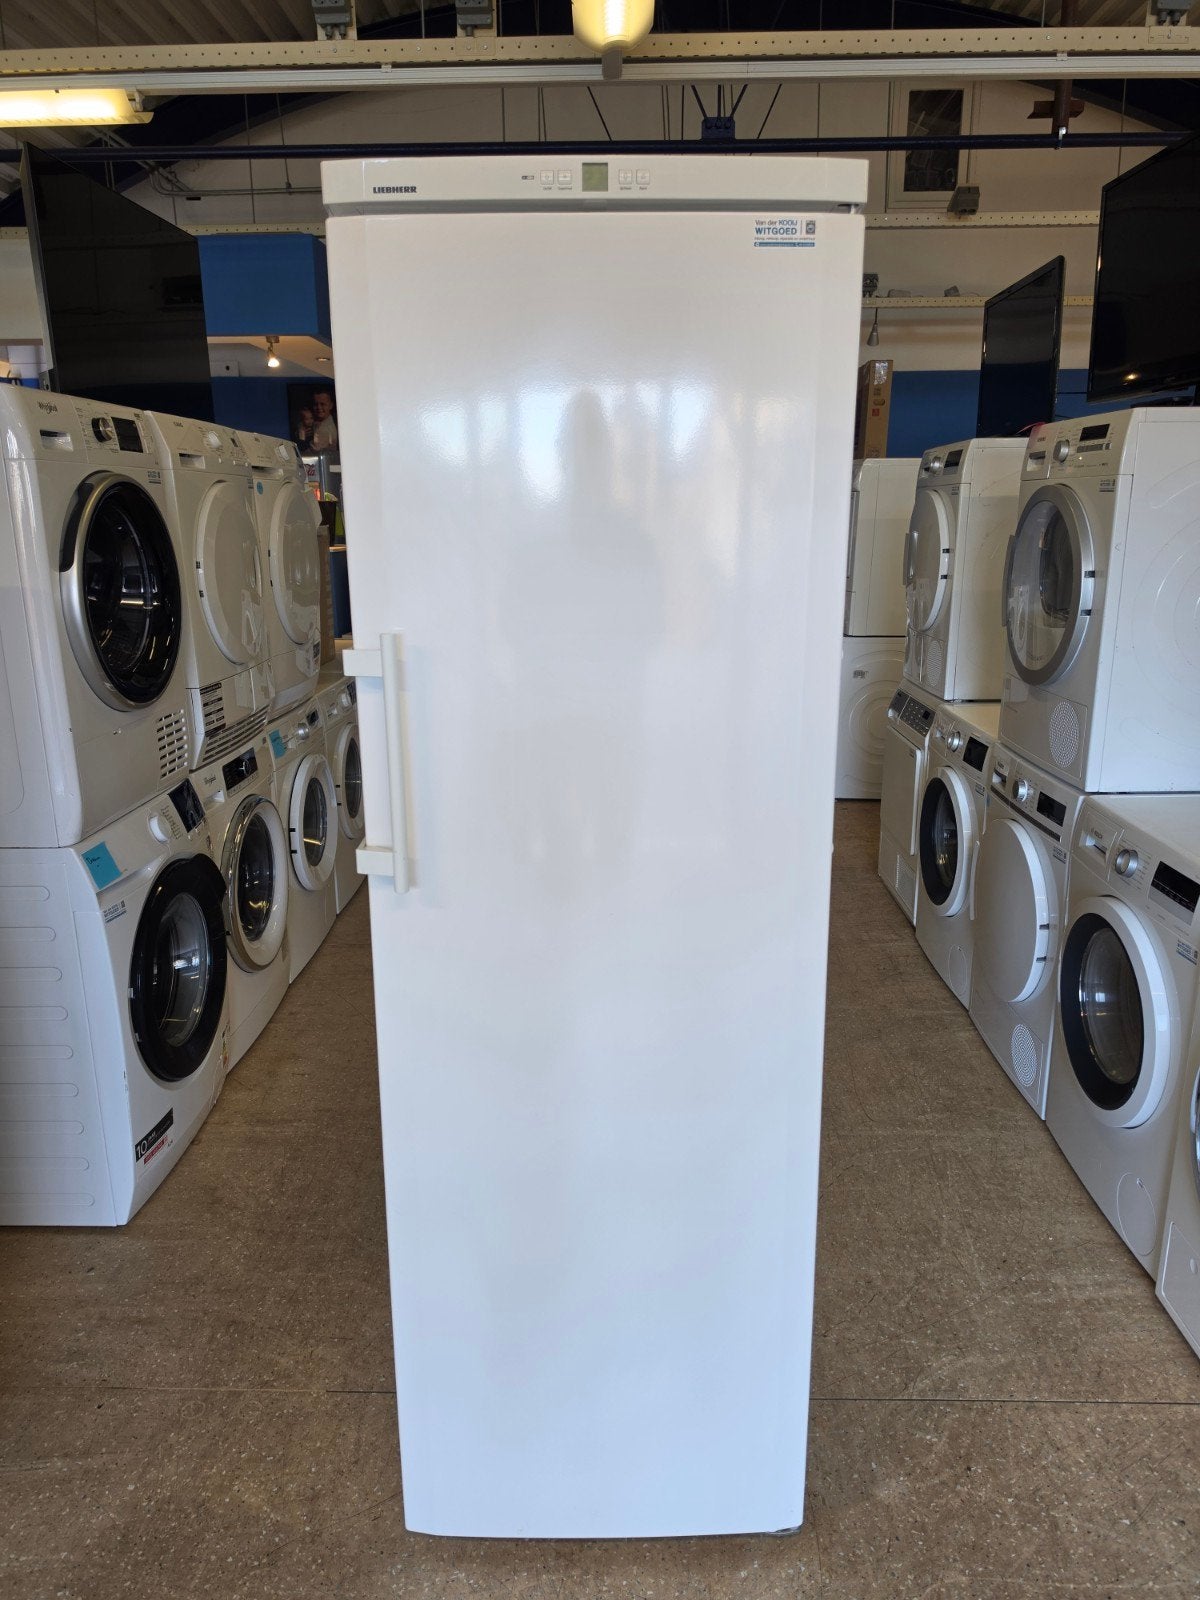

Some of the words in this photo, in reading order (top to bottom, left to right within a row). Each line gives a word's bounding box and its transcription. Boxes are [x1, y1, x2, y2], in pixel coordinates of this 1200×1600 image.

[373, 186, 417, 194] LIEBHERR
[755, 219, 767, 227] Van
[768, 219, 777, 227] der
[755, 227, 797, 235] WITGOED
[136, 1141, 148, 1159] 10
